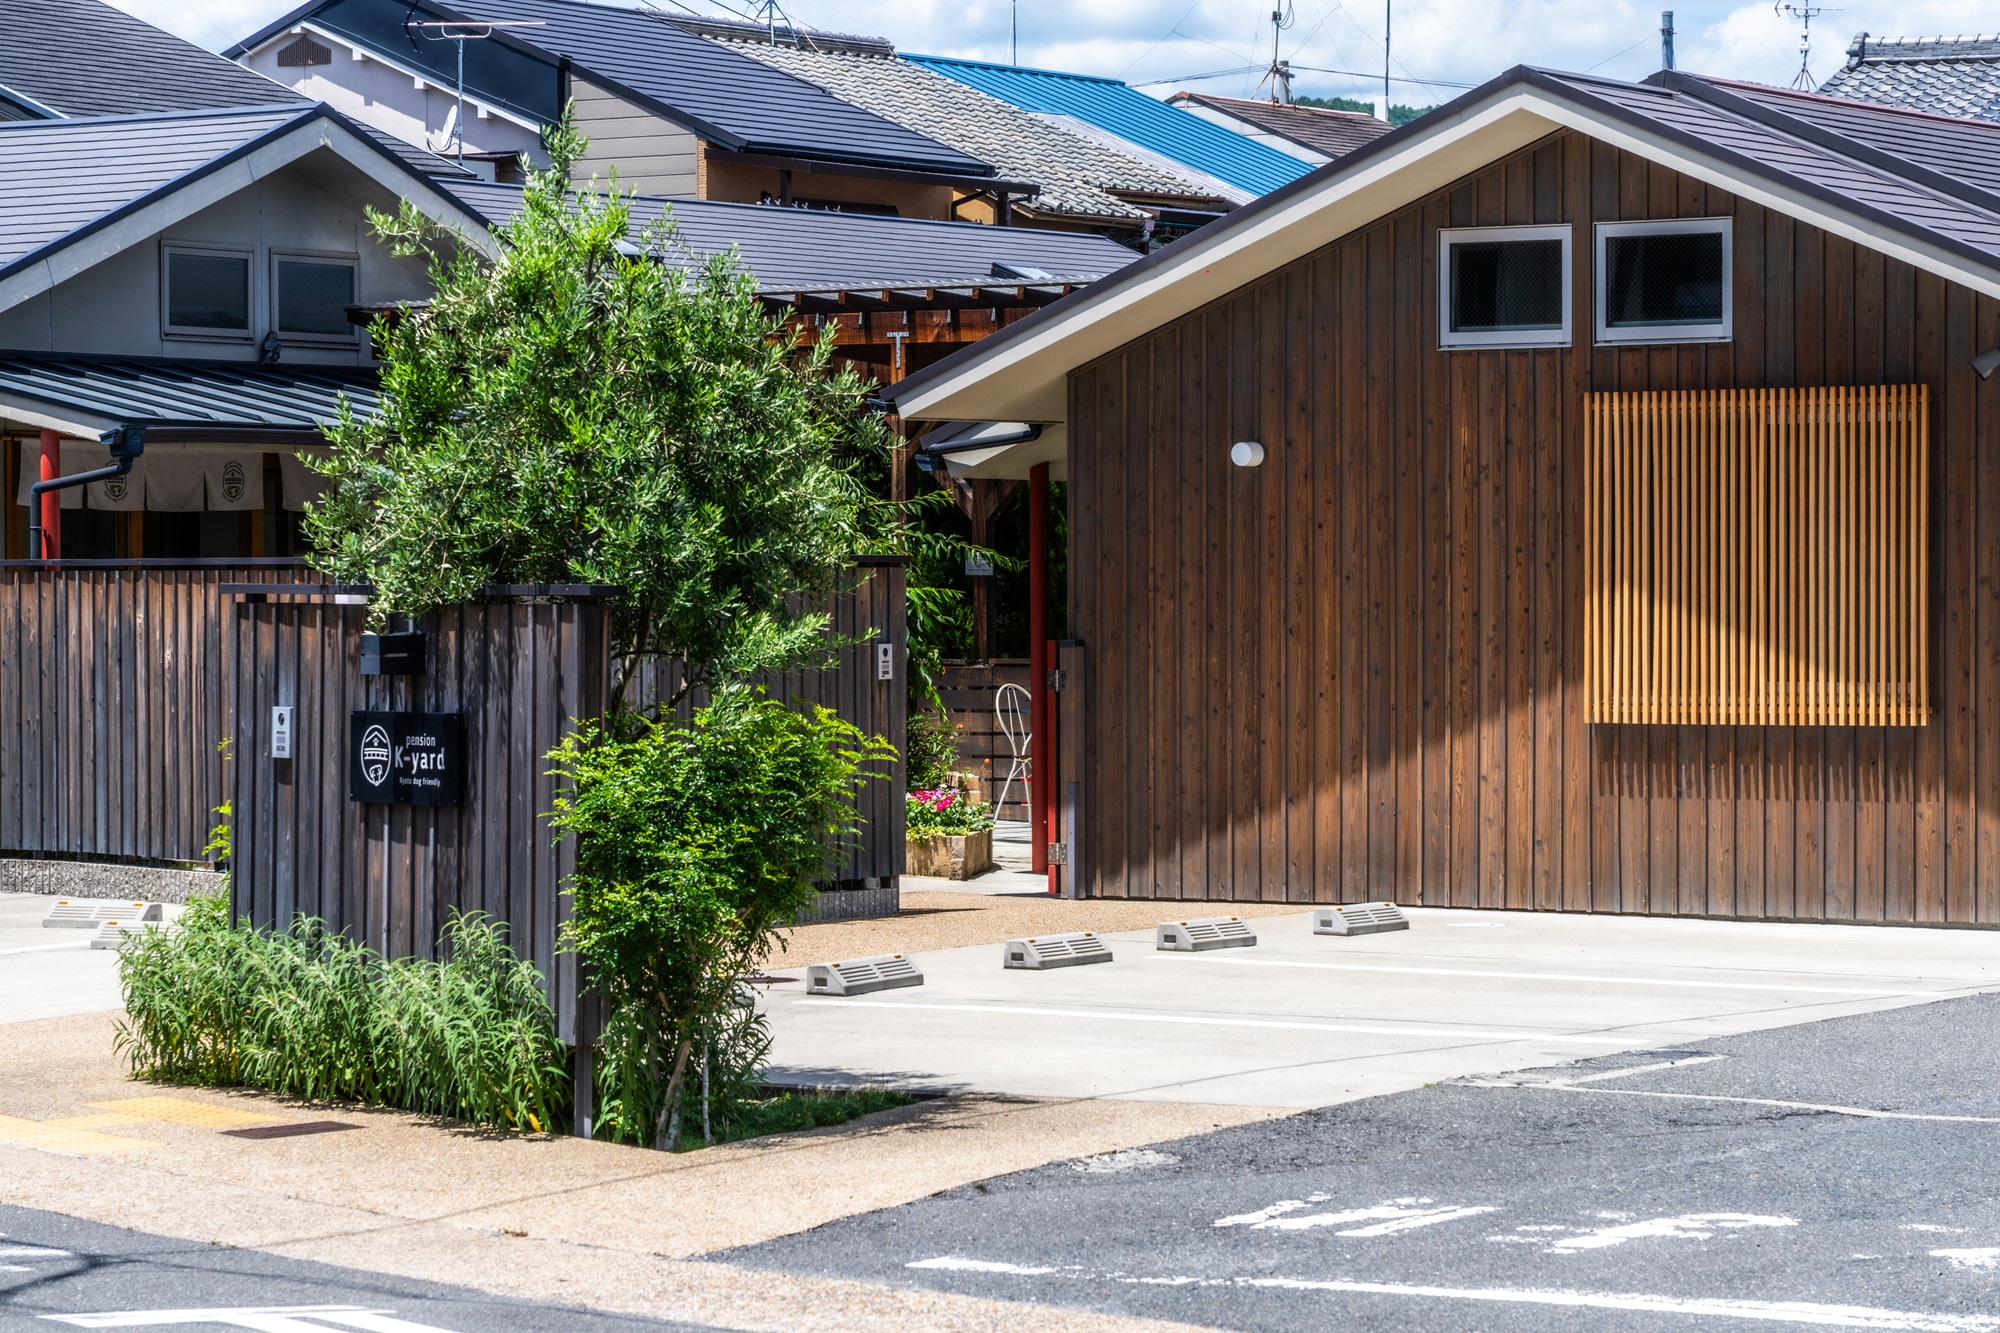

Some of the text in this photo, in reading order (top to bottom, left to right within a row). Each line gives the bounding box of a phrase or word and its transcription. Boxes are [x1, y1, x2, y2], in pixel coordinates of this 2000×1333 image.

[405, 733, 436, 749] pension
[395, 745, 445, 774] K-yard
[399, 777, 412, 786] Kyoto
[413, 777, 422, 787] dog
